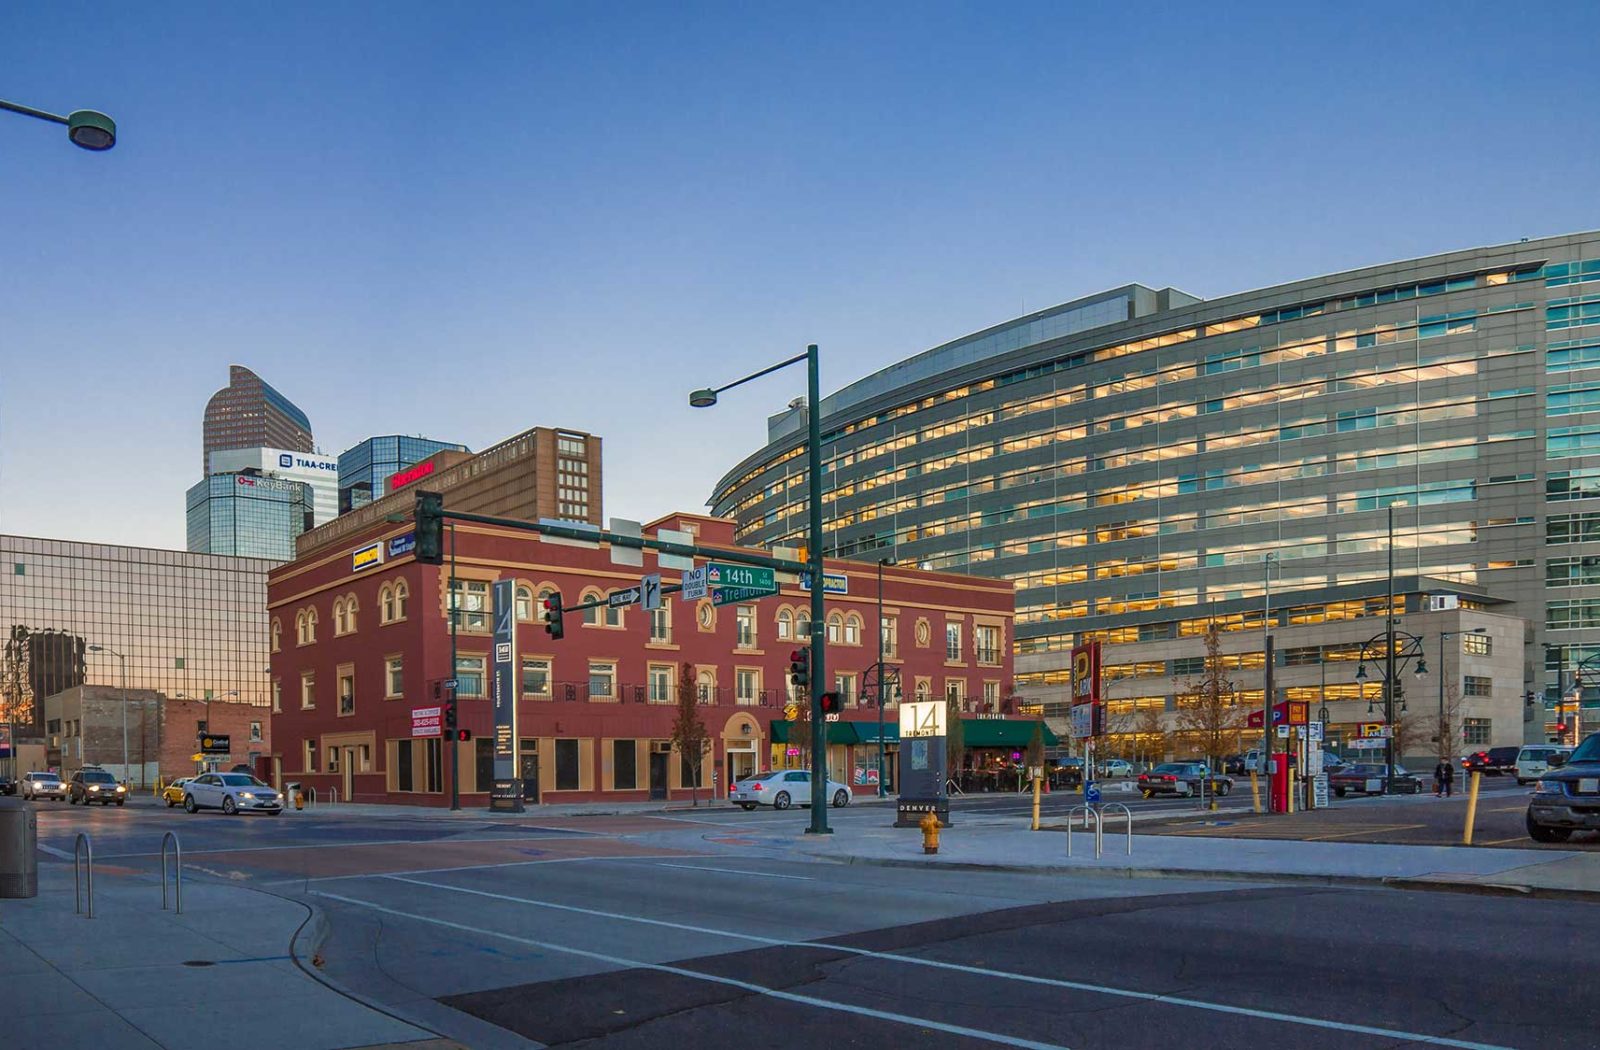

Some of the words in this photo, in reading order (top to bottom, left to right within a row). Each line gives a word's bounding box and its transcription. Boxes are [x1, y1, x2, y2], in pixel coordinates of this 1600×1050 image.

[296, 458, 338, 471] TIAA-CRE
[256, 479, 301, 491] KeyBank
[689, 569, 701, 580] NO
[725, 568, 753, 584] 14th
[685, 579, 705, 590] DOUBLE
[611, 595, 622, 603] ONE
[688, 589, 703, 598] TURN
[495, 584, 512, 640] 14
[910, 704, 940, 736] 14
[1273, 711, 1281, 721] P
[905, 729, 935, 737] TREMONT
[900, 804, 937, 812] DENVER
